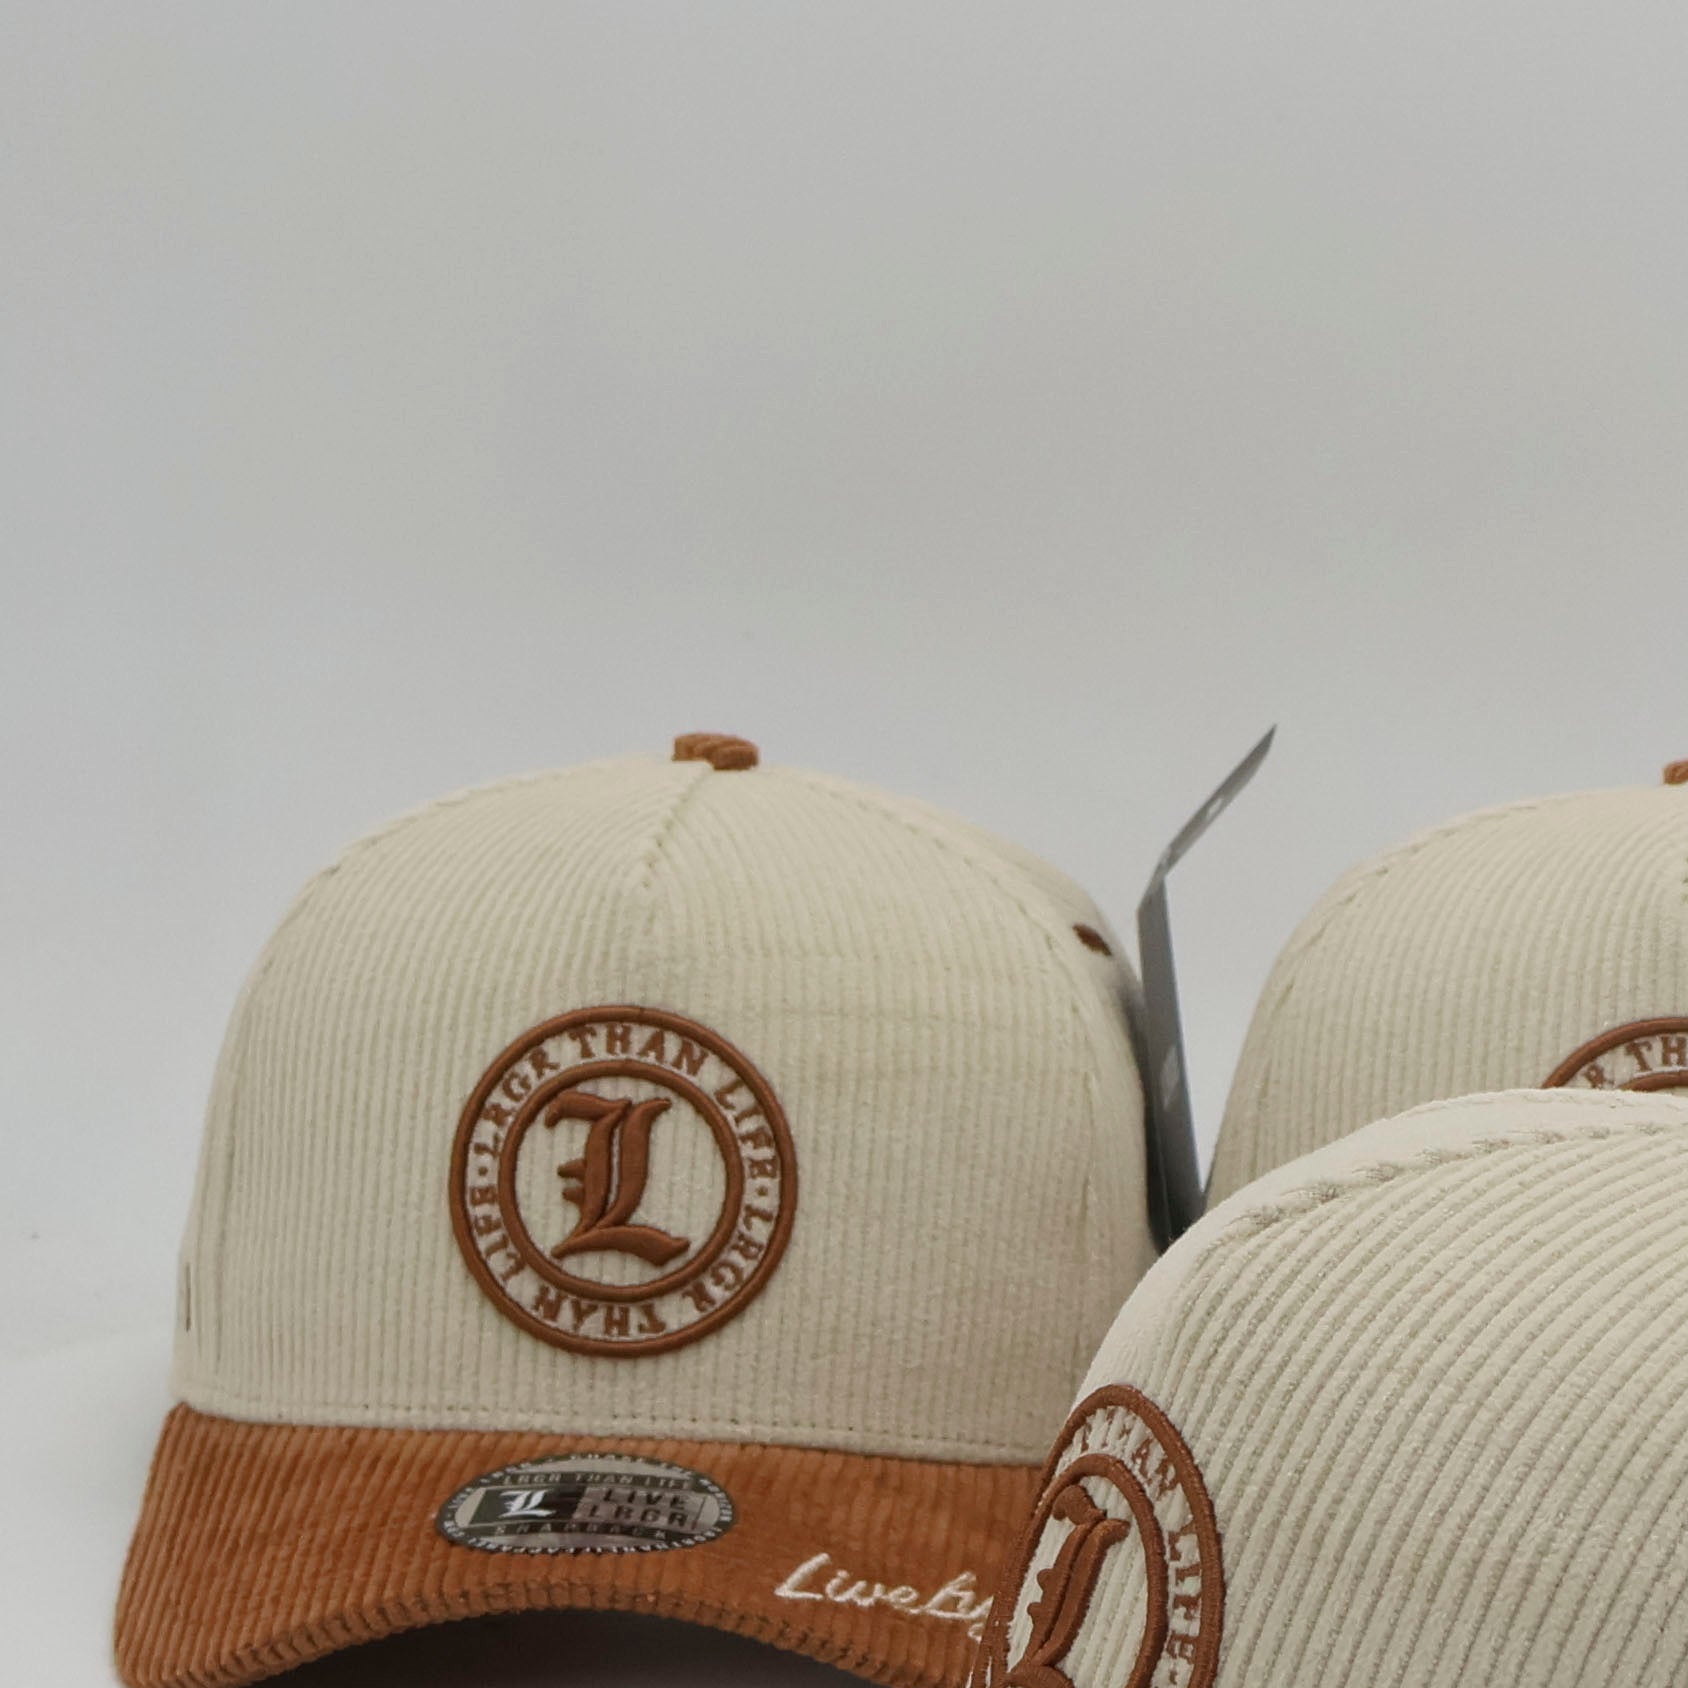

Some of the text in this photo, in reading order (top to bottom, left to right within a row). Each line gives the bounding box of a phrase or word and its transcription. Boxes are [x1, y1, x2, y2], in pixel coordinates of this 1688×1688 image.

[475, 1023, 779, 1178] LRGR THAN LIFE
[544, 1091, 690, 1266] L
[470, 1187, 773, 1336] LRGR THAN LIFE
[589, 1504, 688, 1527] LRGR
[603, 1489, 686, 1510] LIVE
[1168, 1516, 1201, 1661] LIFE
